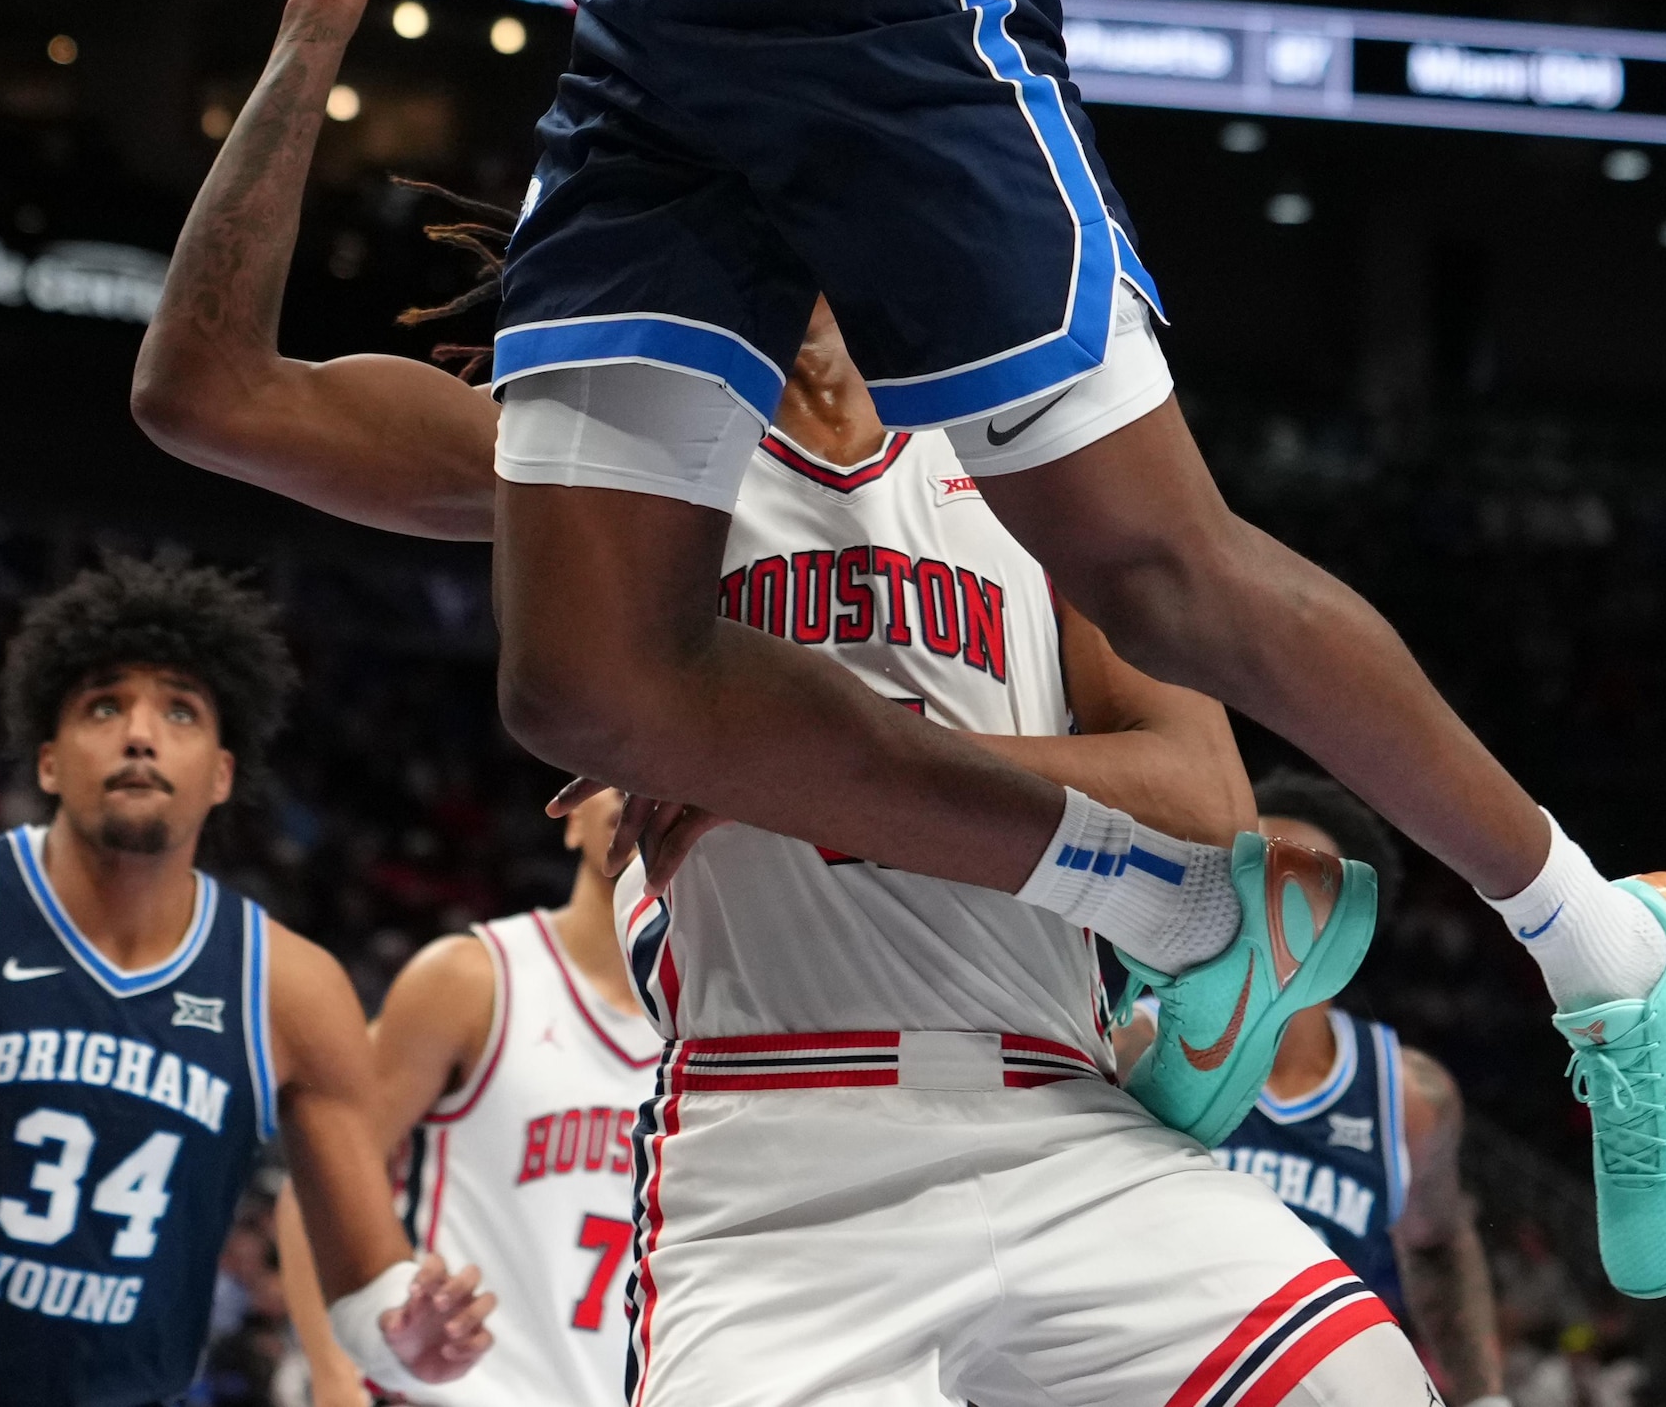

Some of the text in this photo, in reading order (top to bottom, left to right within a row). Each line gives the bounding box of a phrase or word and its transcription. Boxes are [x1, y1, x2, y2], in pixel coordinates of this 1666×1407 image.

[515, 1107, 635, 1185] HOUS
[1210, 1147, 1376, 1240] IGHAM
[571, 1214, 633, 1331] 7
